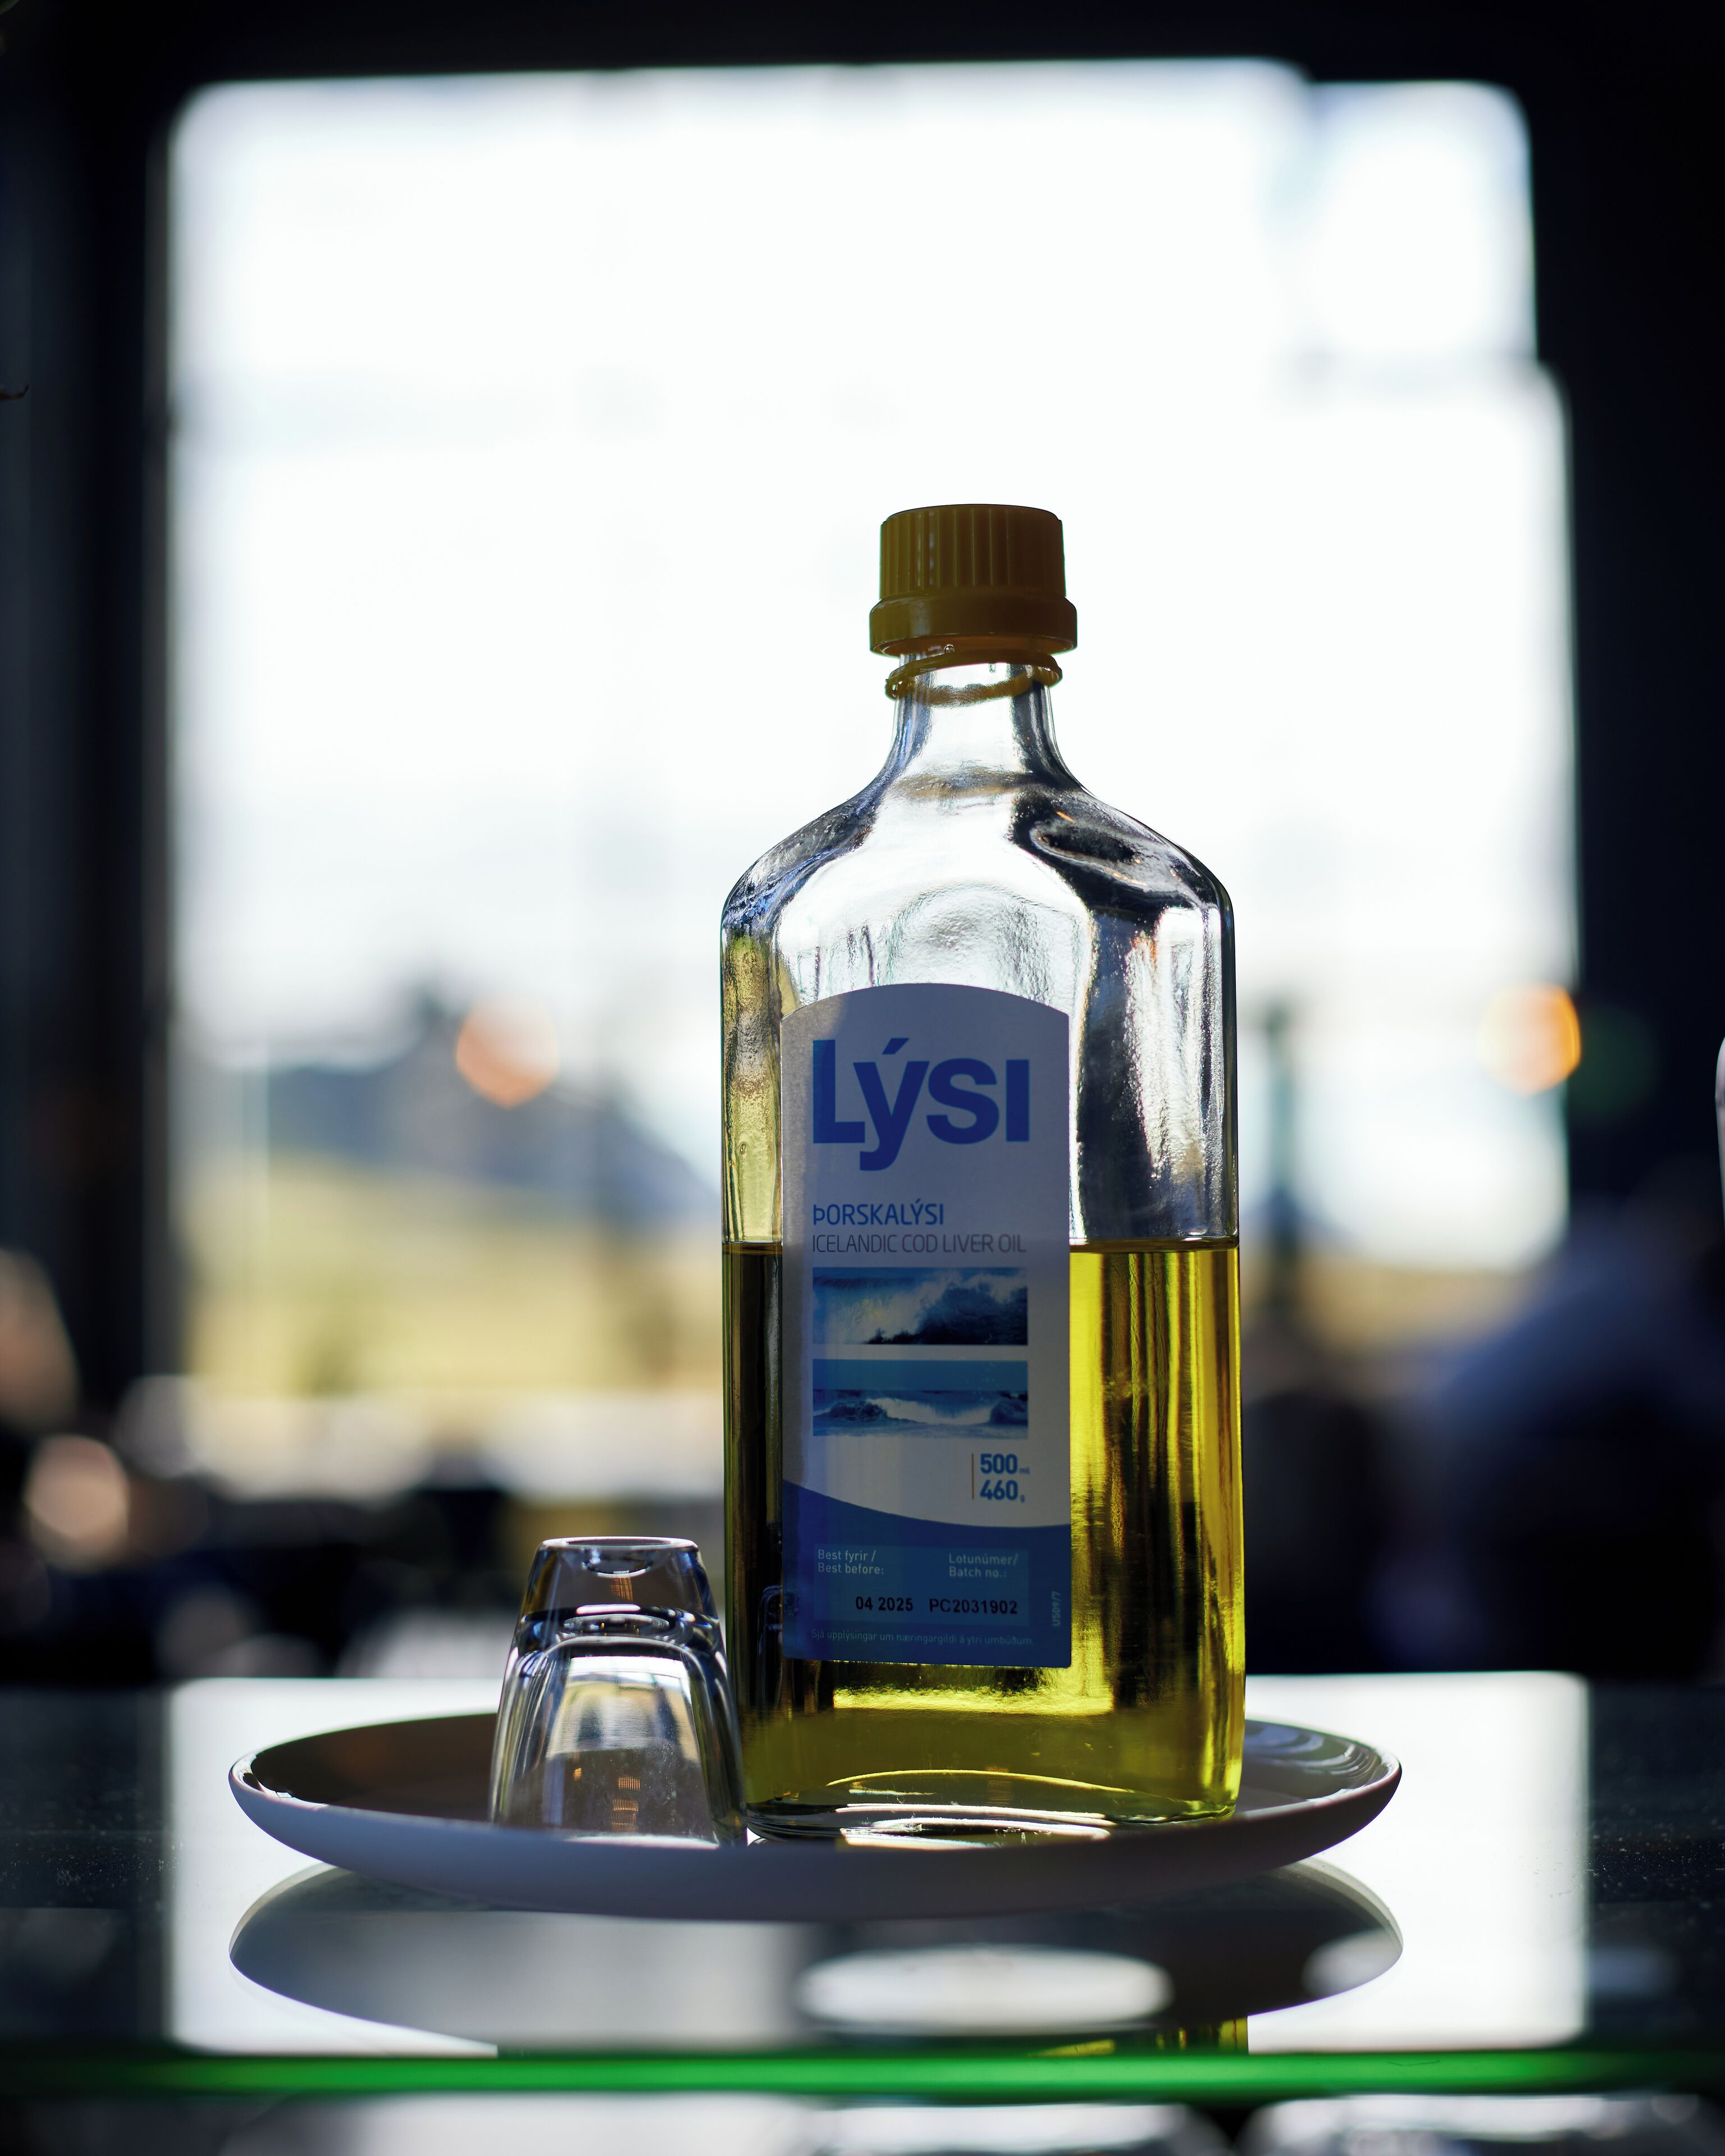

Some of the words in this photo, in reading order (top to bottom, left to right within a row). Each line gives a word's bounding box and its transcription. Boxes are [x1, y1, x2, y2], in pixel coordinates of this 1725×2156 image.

[813, 1198, 944, 1225] ÞORSKALÝSI
[813, 1235, 898, 1253] ICELANDIC
[901, 1235, 938, 1253] COD
[943, 1234, 994, 1253] LIVER
[998, 1234, 1027, 1253] OIL
[980, 1453, 1018, 1474] 500
[979, 1479, 1018, 1500] 460
[818, 1549, 842, 1560] Best
[845, 1550, 868, 1563] fyrir
[818, 1562, 842, 1573] Best
[845, 1564, 884, 1574] before:
[949, 1566, 982, 1578] Batch
[855, 1596, 873, 1610] 04
[878, 1597, 914, 1611] 2025
[929, 1598, 1018, 1615] PC2031902
[811, 1629, 824, 1639] Sjá
[827, 1630, 878, 1642] upplýsingar
[896, 1633, 956, 1646] næringargildi
